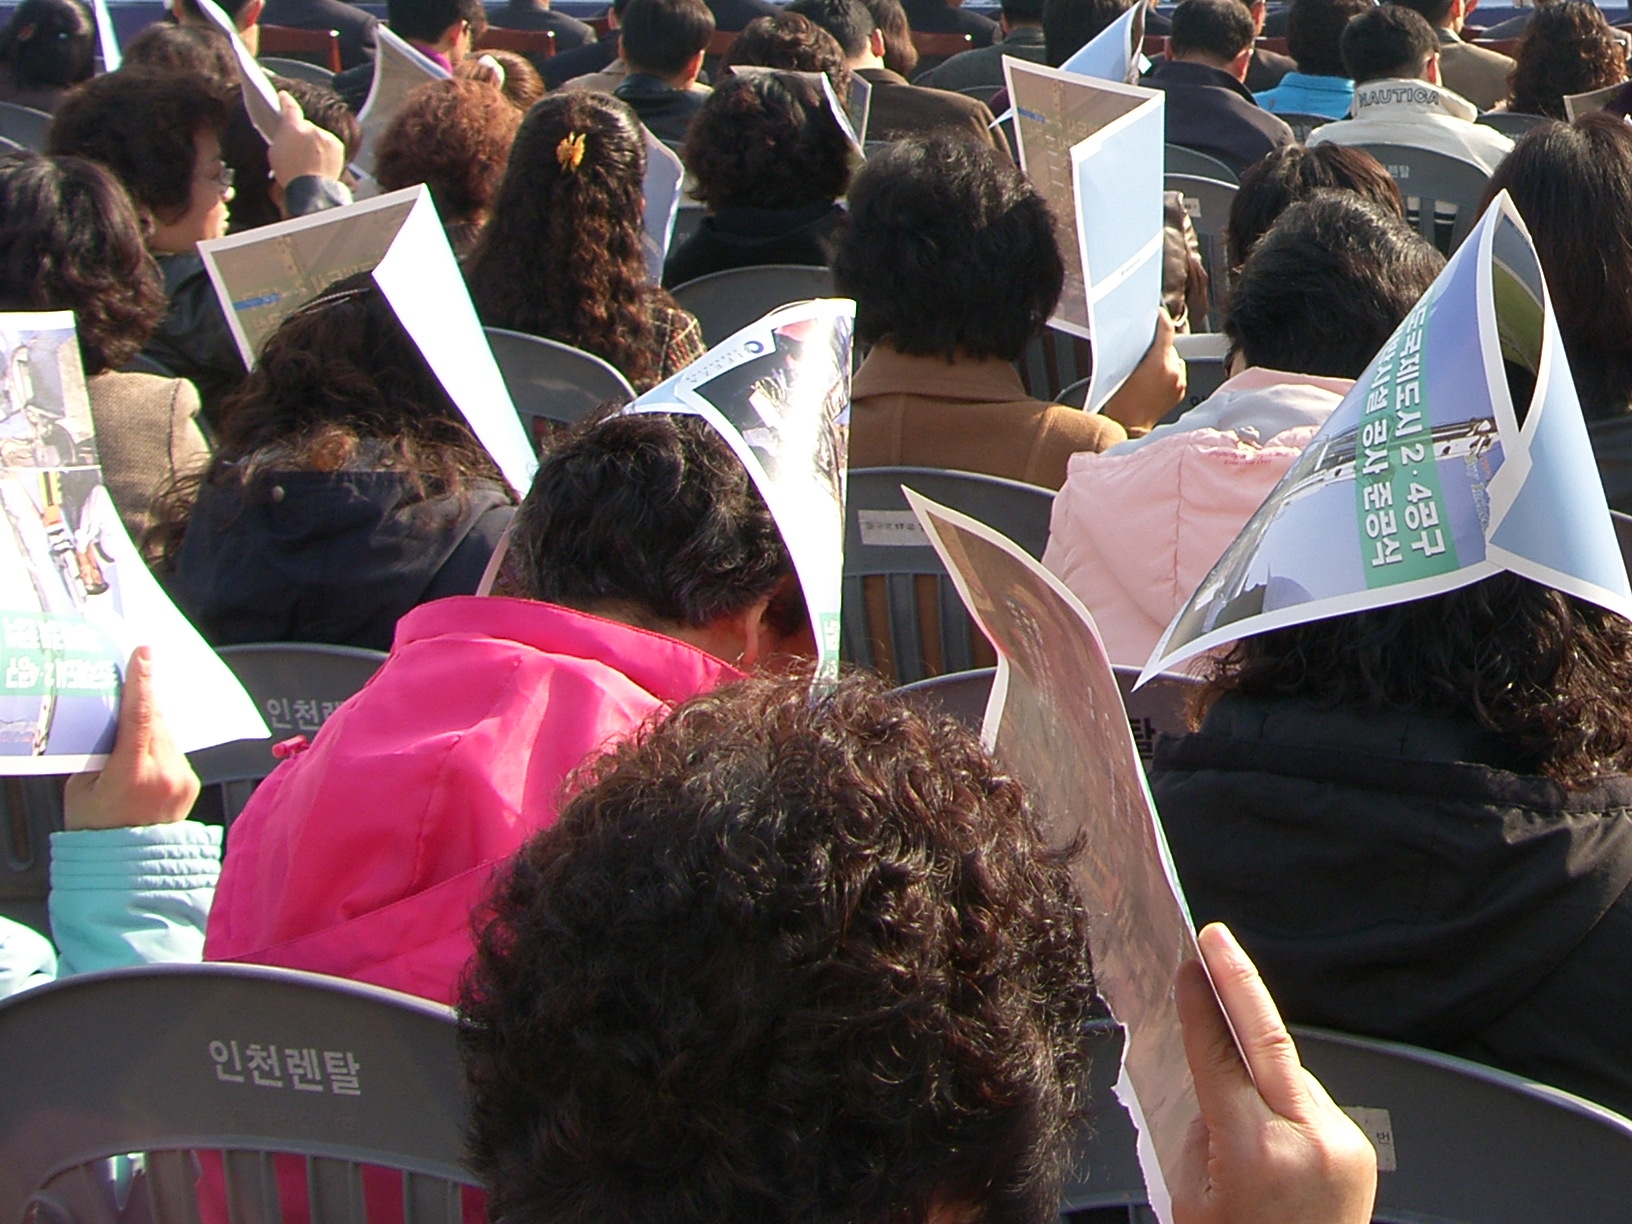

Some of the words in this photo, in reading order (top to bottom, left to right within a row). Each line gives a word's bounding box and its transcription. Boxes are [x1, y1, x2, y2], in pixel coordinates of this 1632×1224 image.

[1358, 87, 1440, 108] NAUTICA
[1362, 418, 1389, 475] 공사
[1363, 481, 1403, 568] 준공식
[208, 1039, 362, 1096] 인천렌탈
